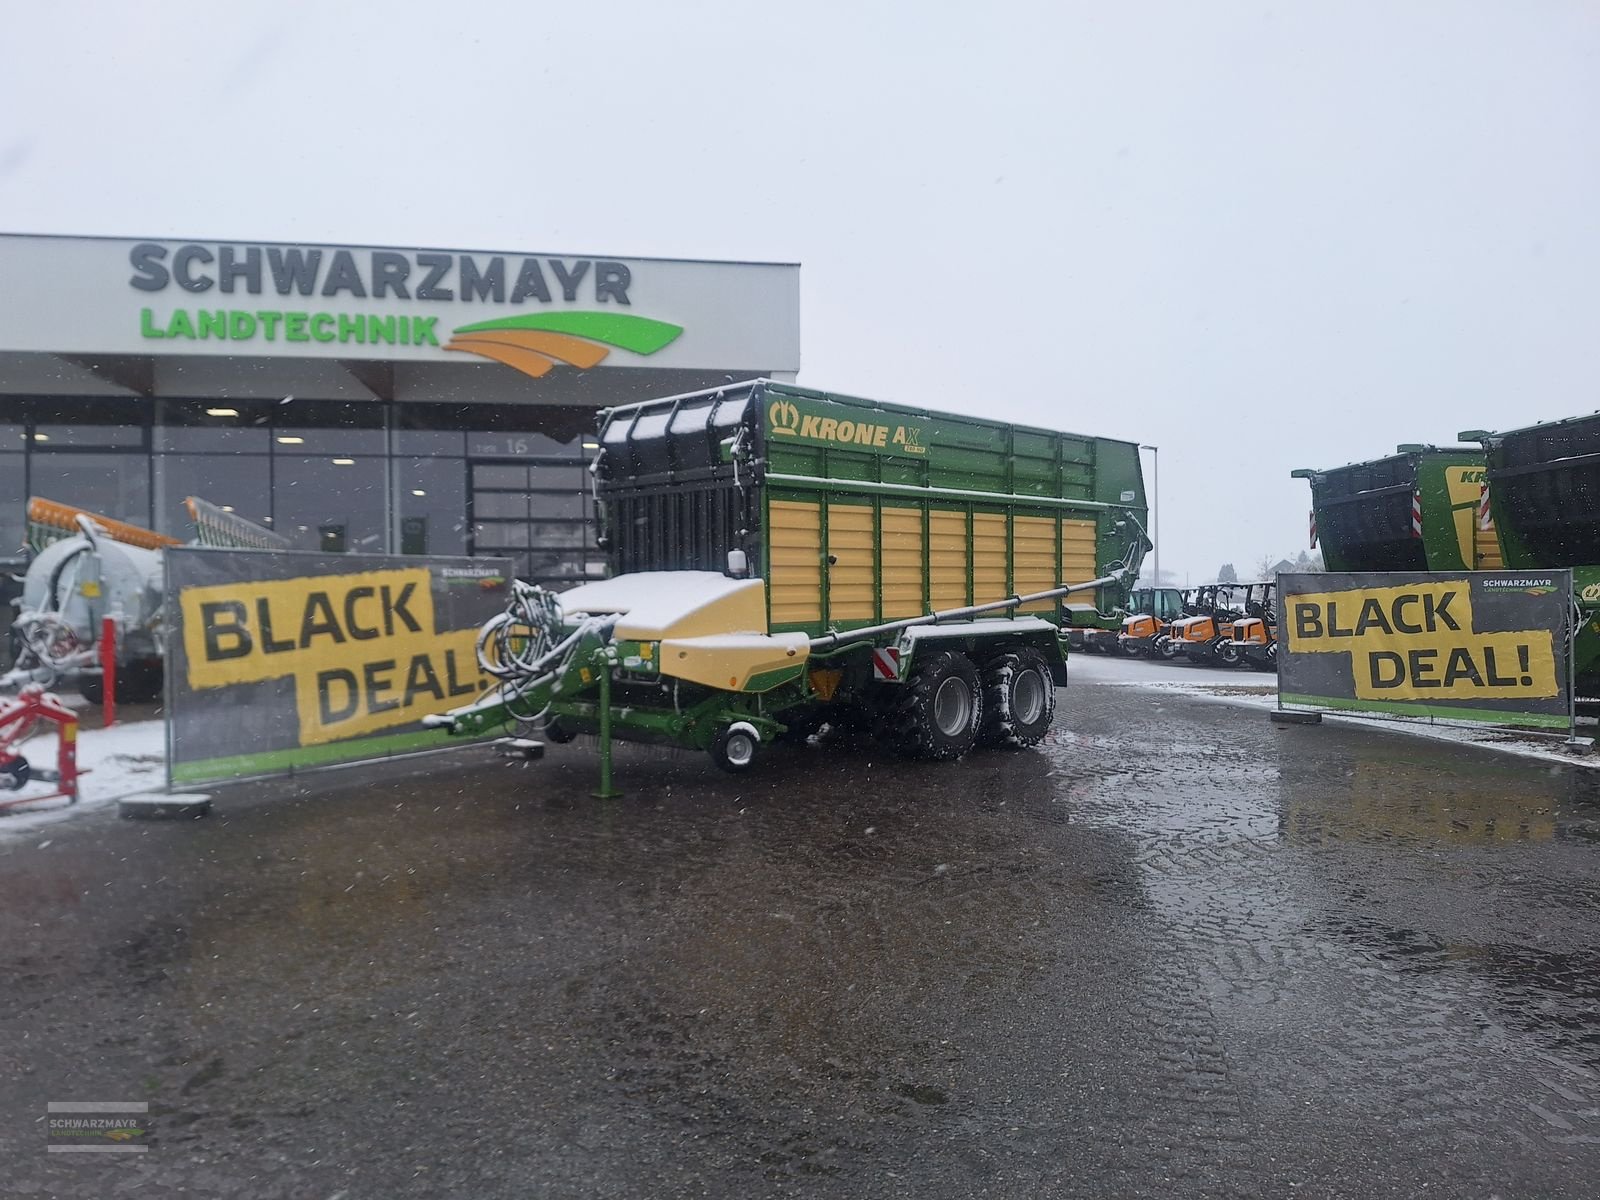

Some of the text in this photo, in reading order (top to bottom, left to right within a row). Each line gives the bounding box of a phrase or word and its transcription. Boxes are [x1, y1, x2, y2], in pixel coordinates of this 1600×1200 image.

[129, 242, 632, 305] SCHWARZMAYR
[140, 308, 440, 347] LANDTECHNIK
[507, 438, 529, 454] 16
[801, 415, 889, 448] KRONE
[1483, 579, 1552, 587] SCHWARZMAYR
[200, 582, 422, 661] BLACK
[1295, 591, 1461, 638] BLACK
[1368, 644, 1533, 689] DEAL!
